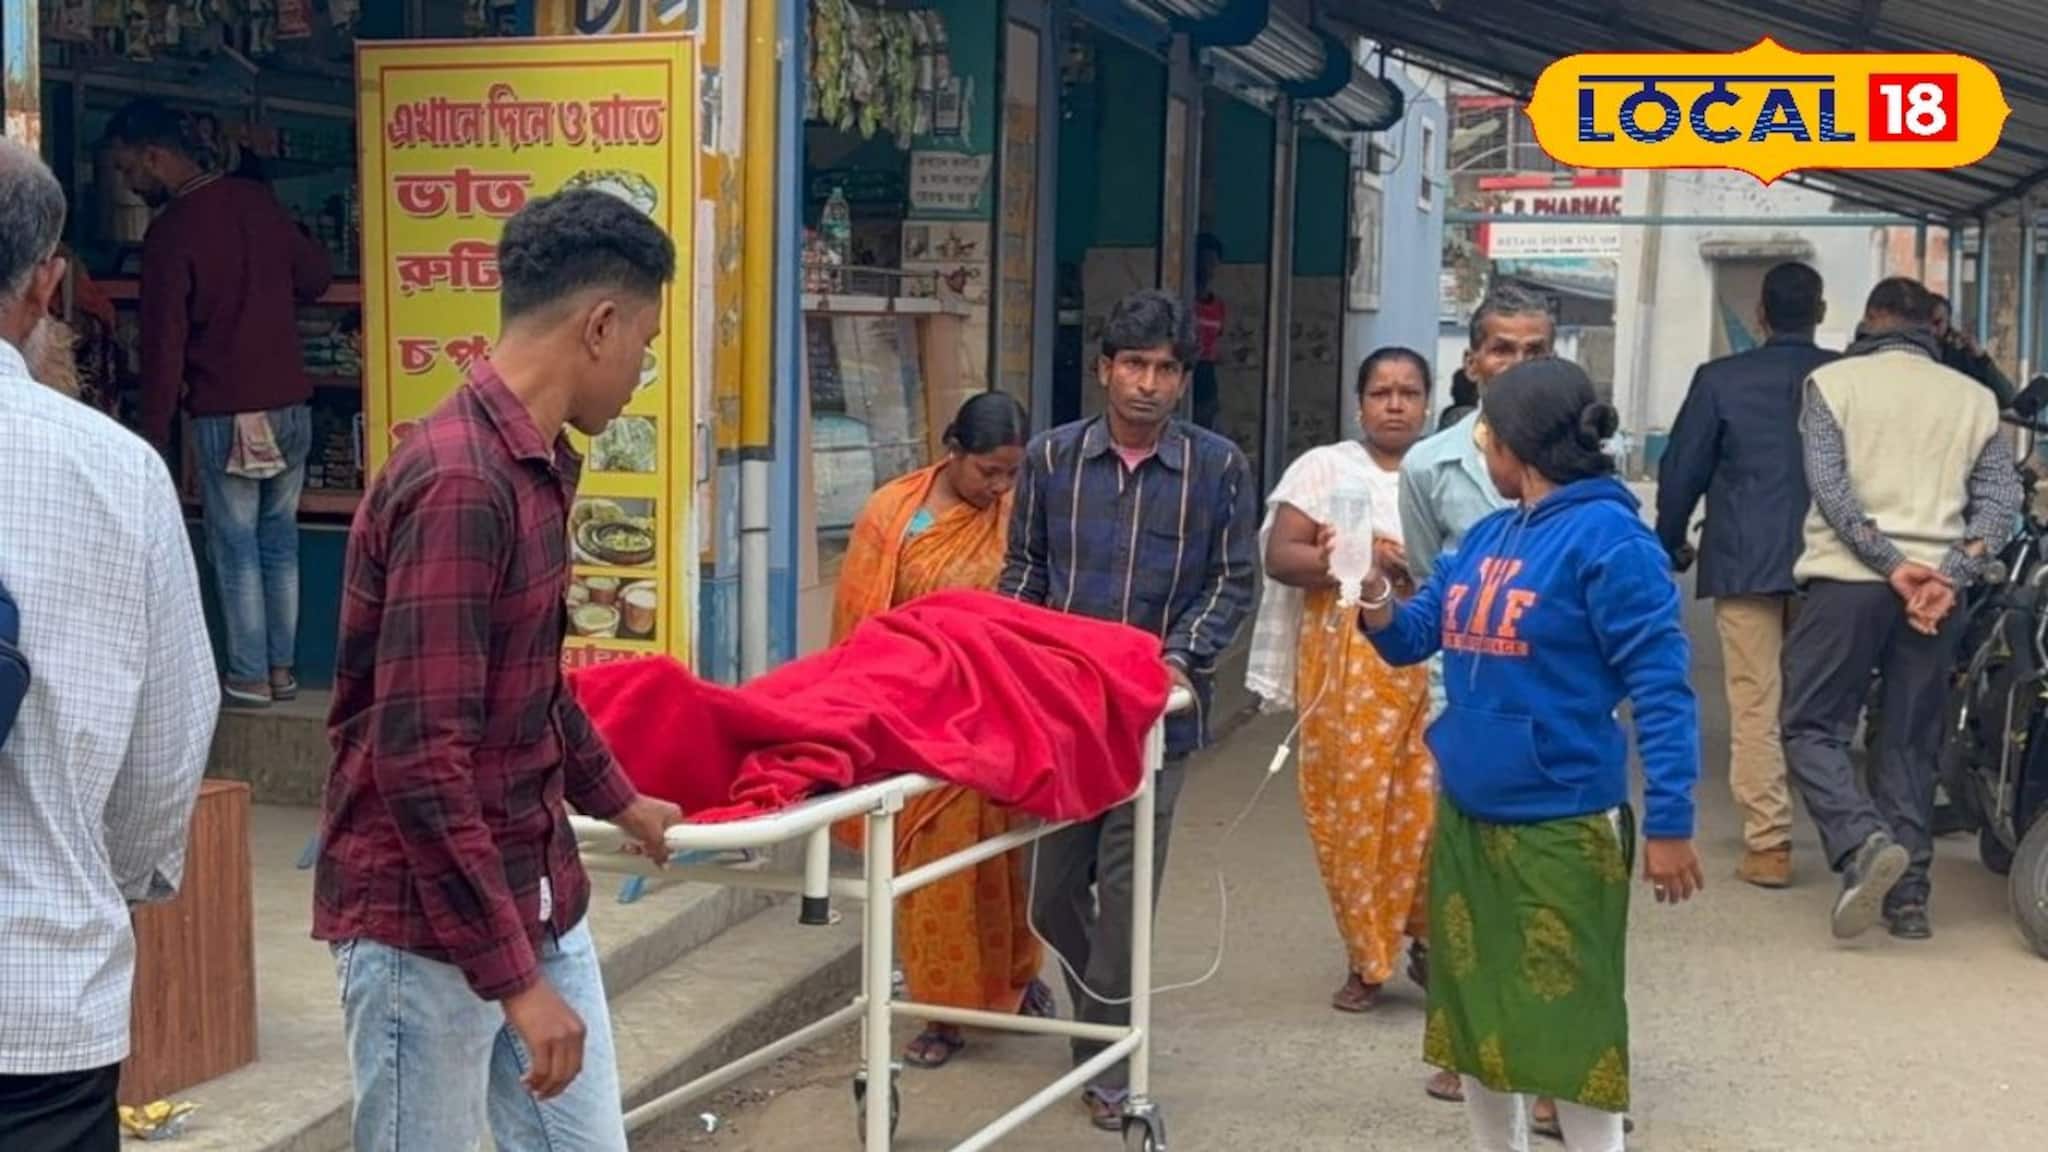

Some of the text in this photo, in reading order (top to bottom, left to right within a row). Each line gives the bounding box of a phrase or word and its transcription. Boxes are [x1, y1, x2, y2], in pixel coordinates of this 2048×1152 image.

[388, 83, 666, 152] এখানে দিনে ও রাতে
[395, 168, 531, 219] ভাত
[1533, 195, 1622, 215] PHARMAC
